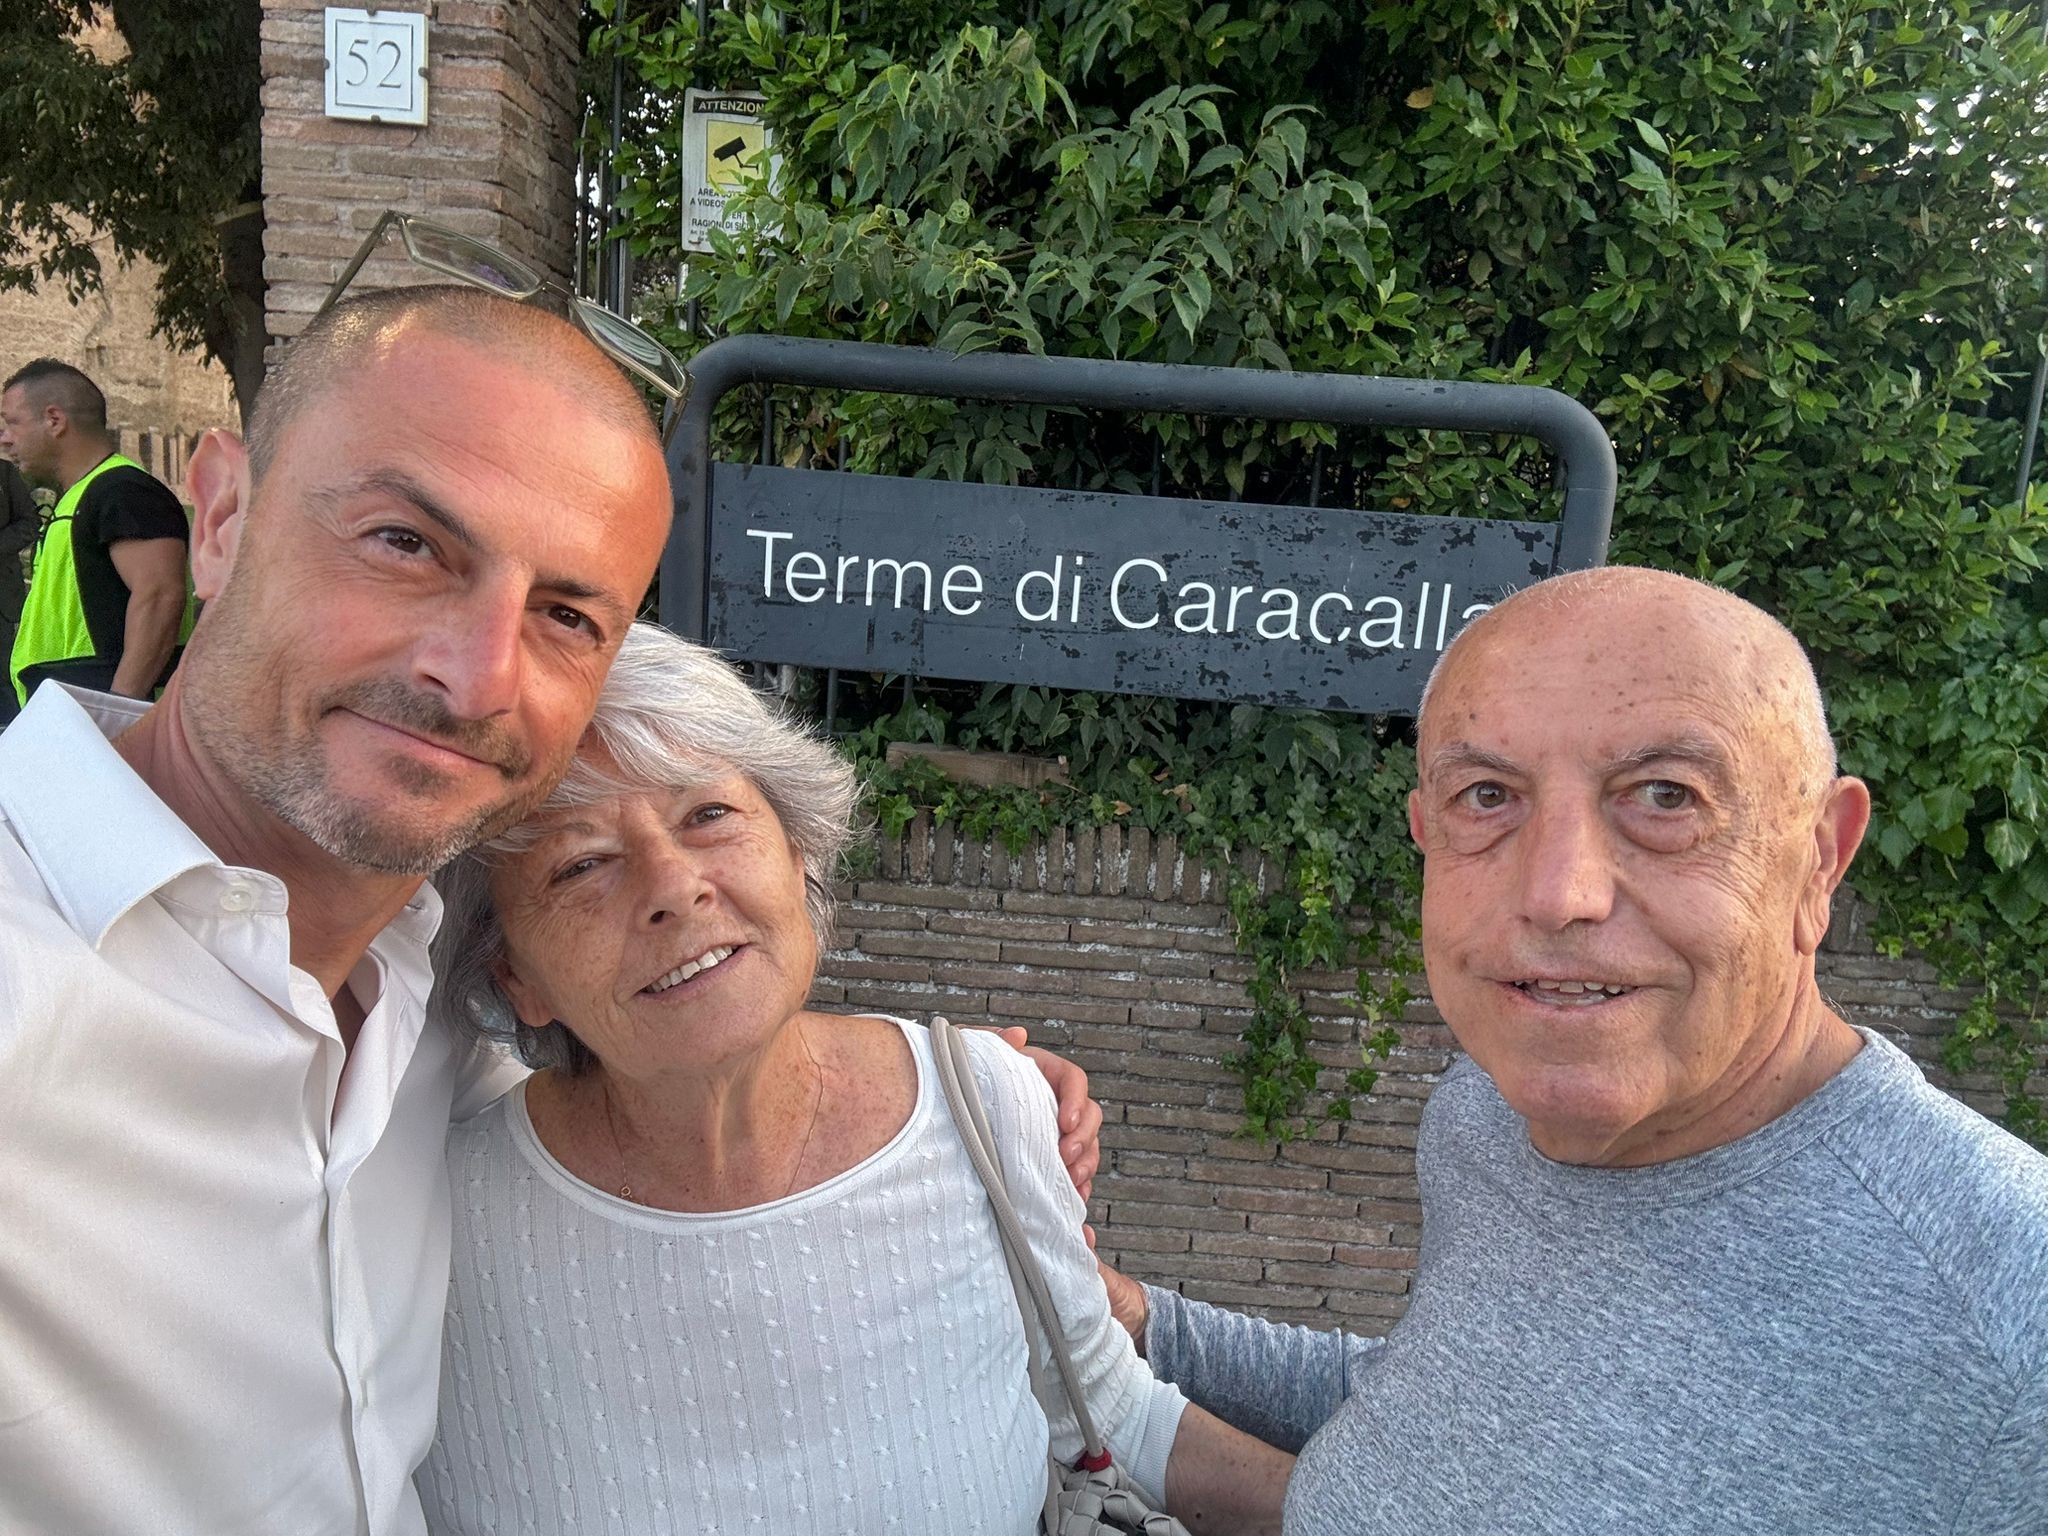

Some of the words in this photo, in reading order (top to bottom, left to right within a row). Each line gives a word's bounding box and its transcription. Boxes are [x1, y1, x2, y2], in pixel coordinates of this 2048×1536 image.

[346, 39, 401, 88] 52
[698, 100, 764, 113] ATTENZION
[690, 198, 696, 206] A
[697, 198, 726, 208] VIDEOS
[746, 529, 983, 616] Terme
[1015, 555, 1082, 623] di
